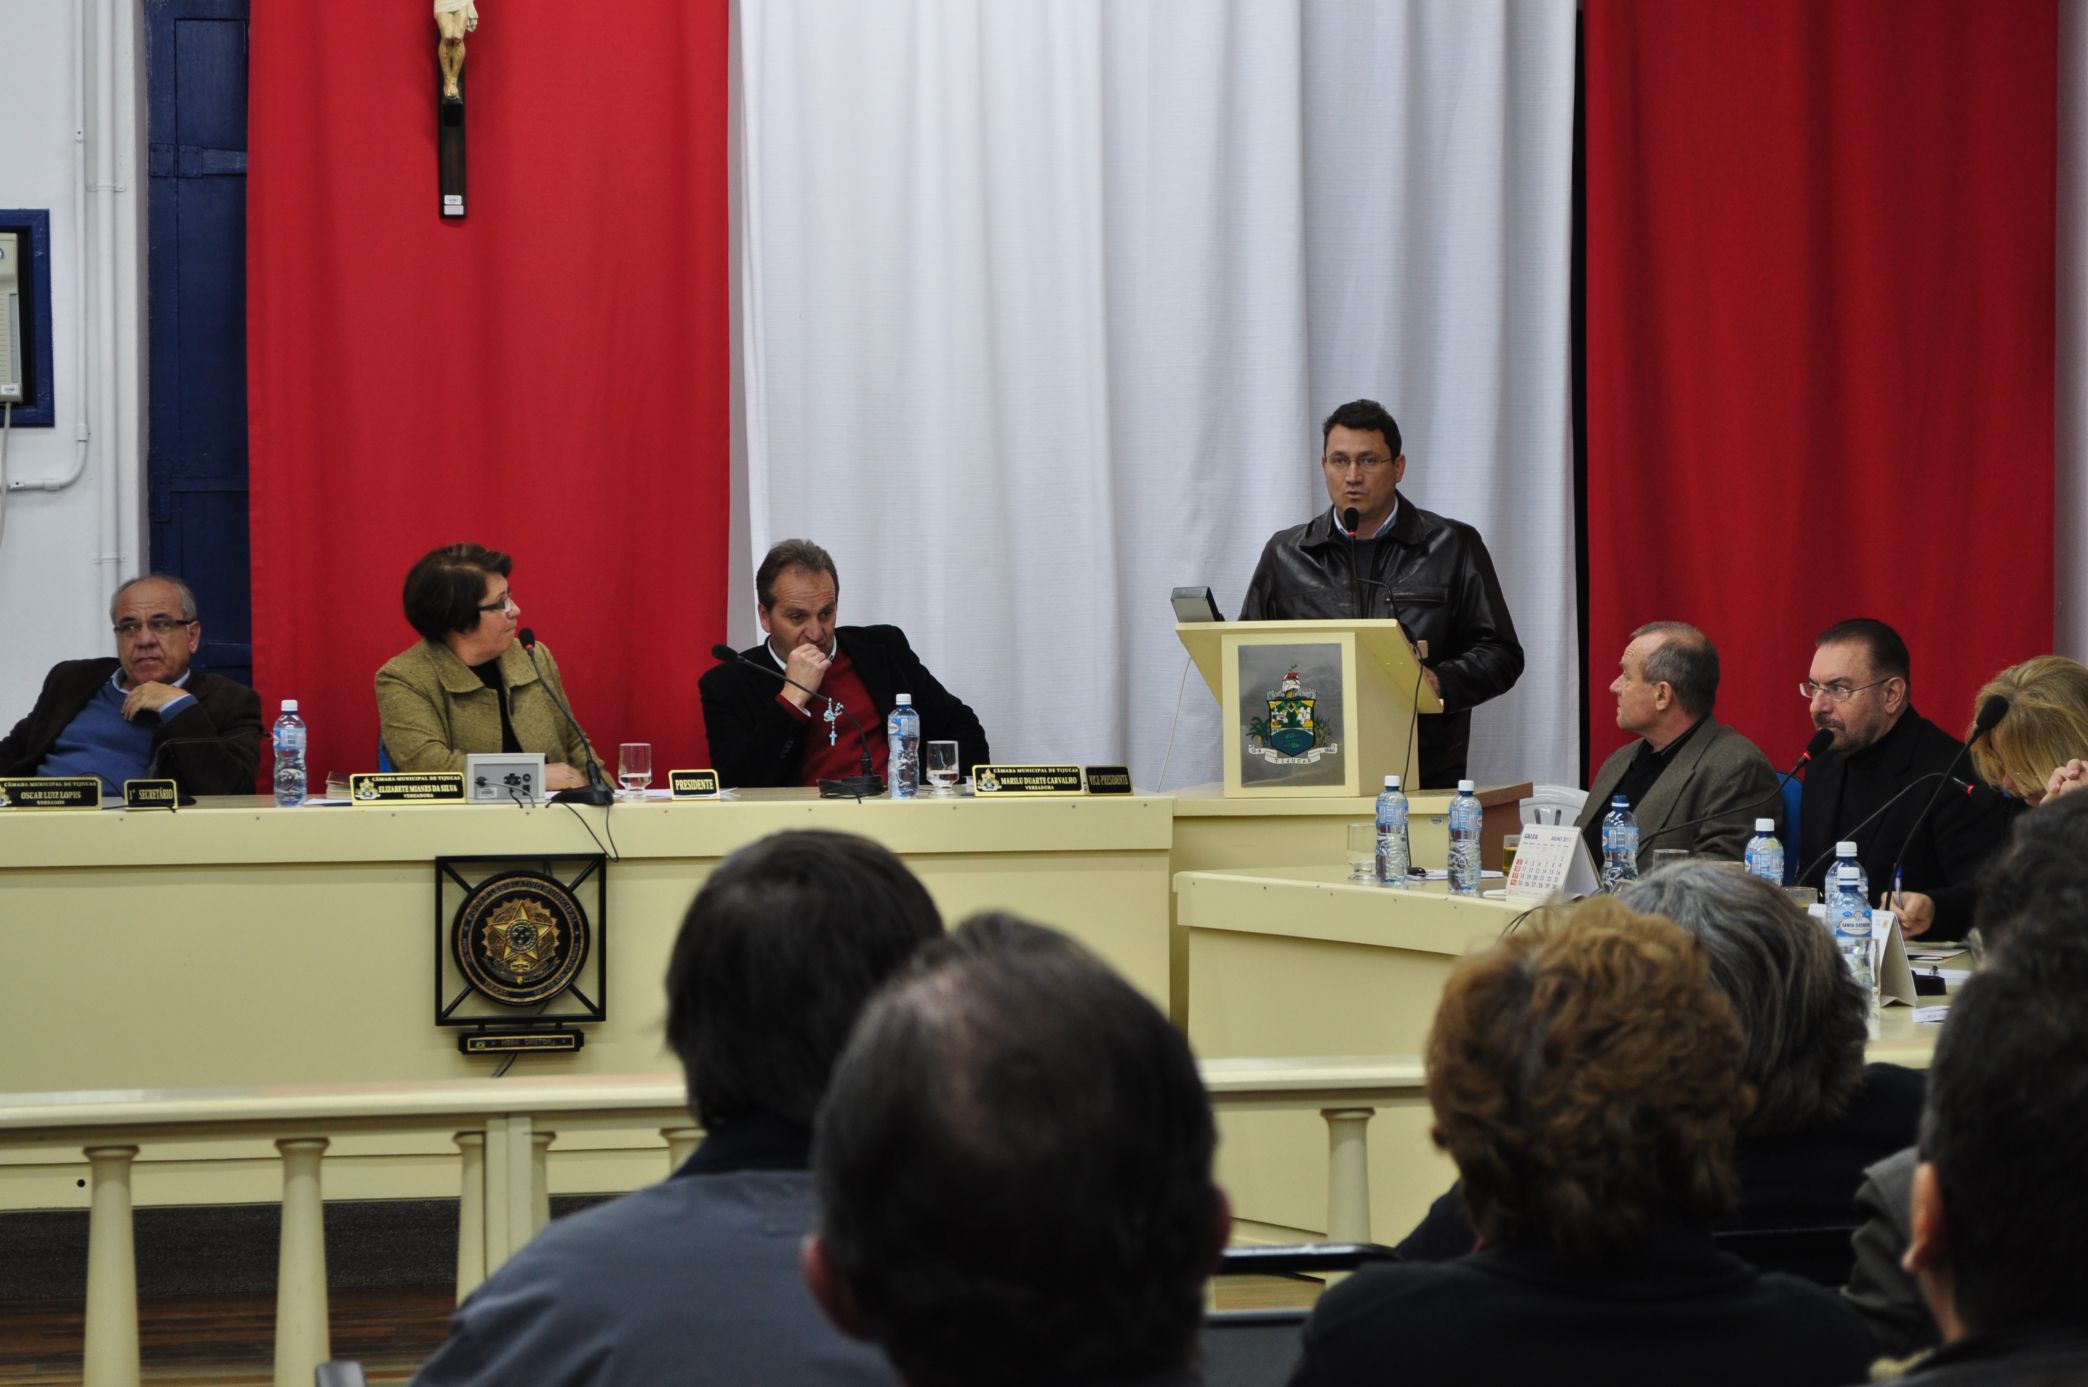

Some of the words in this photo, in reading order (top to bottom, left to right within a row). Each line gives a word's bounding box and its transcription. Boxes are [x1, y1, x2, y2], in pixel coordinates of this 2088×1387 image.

[675, 779, 714, 790] PRESIDENTE
[1001, 777, 1024, 785] MARILU
[1025, 777, 1046, 785] DUARTE
[1047, 777, 1078, 785] CARVALHO
[378, 785, 409, 793] ELIZABETE
[21, 791, 43, 799] OSCAR
[44, 791, 59, 799] LUIZ
[60, 791, 81, 799] LOPES
[138, 787, 173, 800] SECRETÁRIO
